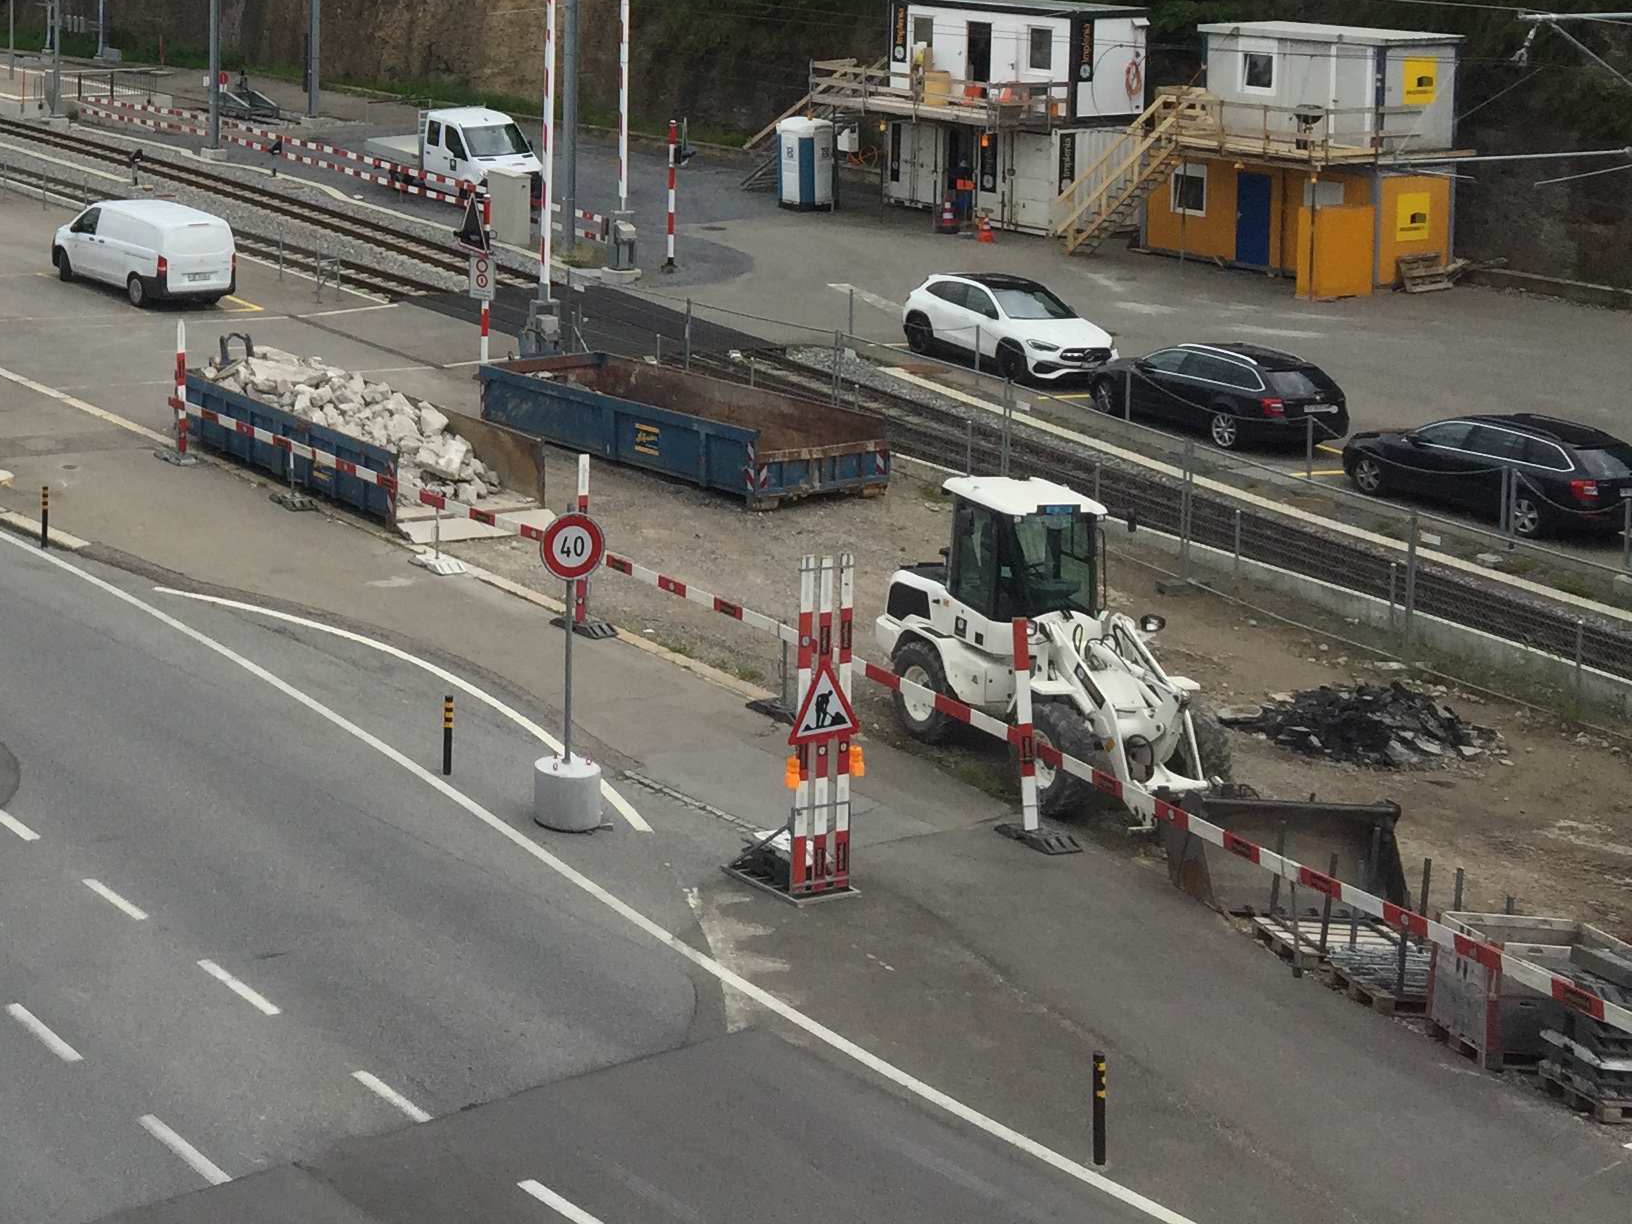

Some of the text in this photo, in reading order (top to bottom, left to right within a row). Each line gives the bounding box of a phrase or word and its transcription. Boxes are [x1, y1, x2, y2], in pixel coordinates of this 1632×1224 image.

[1081, 23, 1092, 63] Implenia
[1063, 137, 1073, 177] Implenia
[560, 535, 585, 558] 40
